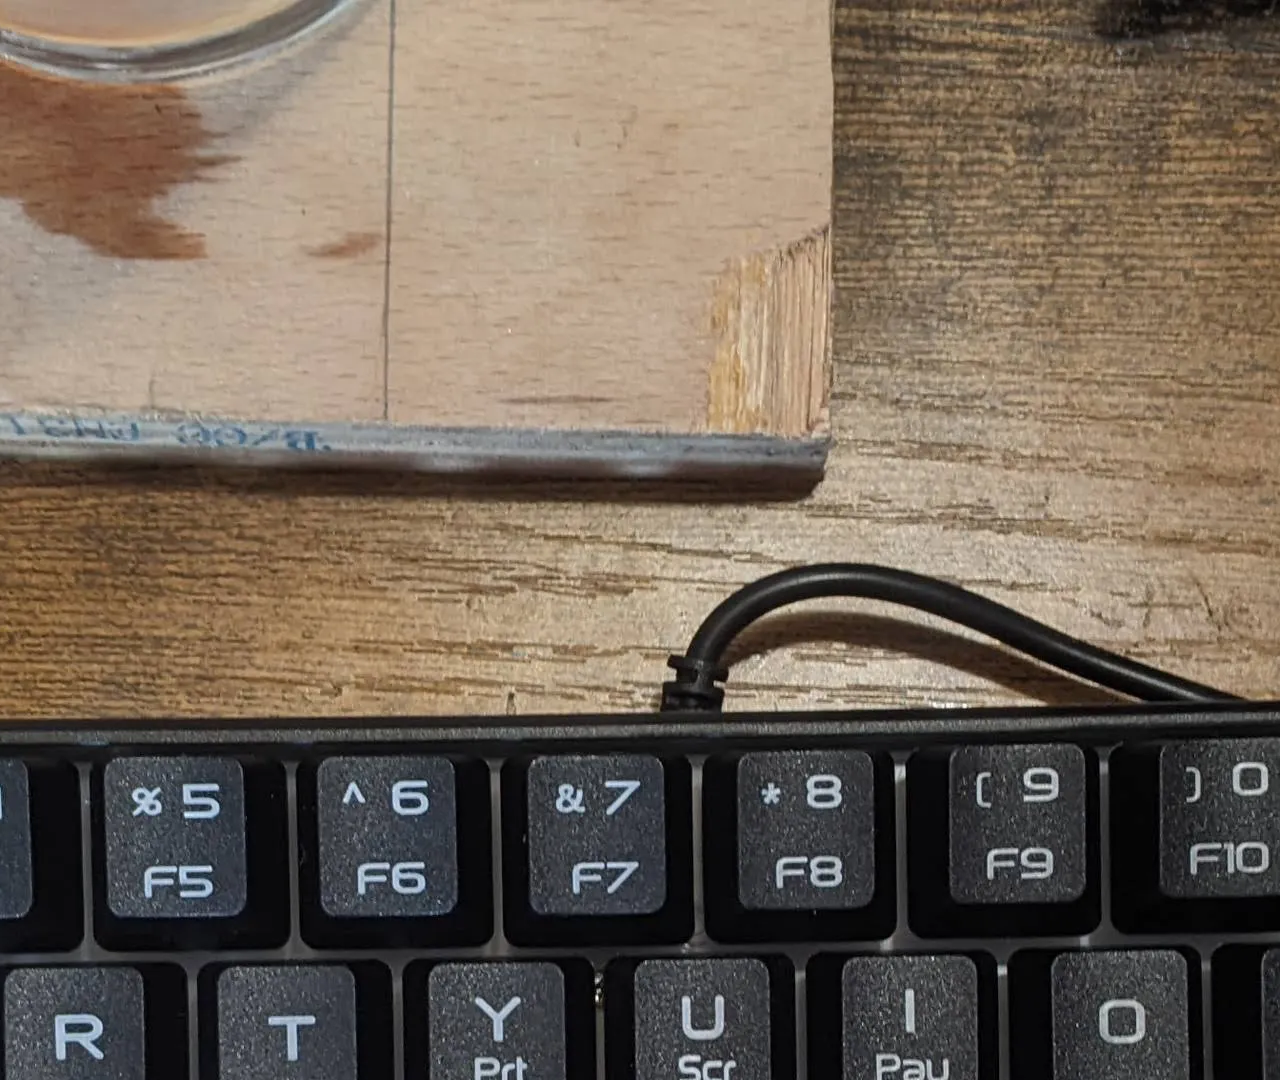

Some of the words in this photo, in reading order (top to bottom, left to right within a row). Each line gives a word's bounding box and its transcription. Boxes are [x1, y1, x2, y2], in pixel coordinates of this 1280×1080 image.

[131, 787, 163, 816] %
[182, 783, 220, 819] 5
[391, 780, 429, 816] 6
[555, 783, 586, 813] &
[604, 780, 641, 816] 7
[806, 774, 843, 809] 8
[1023, 767, 1059, 802] 9
[775, 855, 843, 889] F8
[986, 847, 1054, 880] F9
[1189, 841, 1270, 875] F10
[143, 865, 213, 899] F5
[357, 861, 426, 895] F6
[572, 861, 639, 894] F7
[474, 996, 522, 1042] Y
[681, 994, 725, 1040] U
[904, 988, 916, 1033] I
[1099, 999, 1146, 1044] O
[54, 1013, 104, 1061] R
[267, 1015, 316, 1062] T
